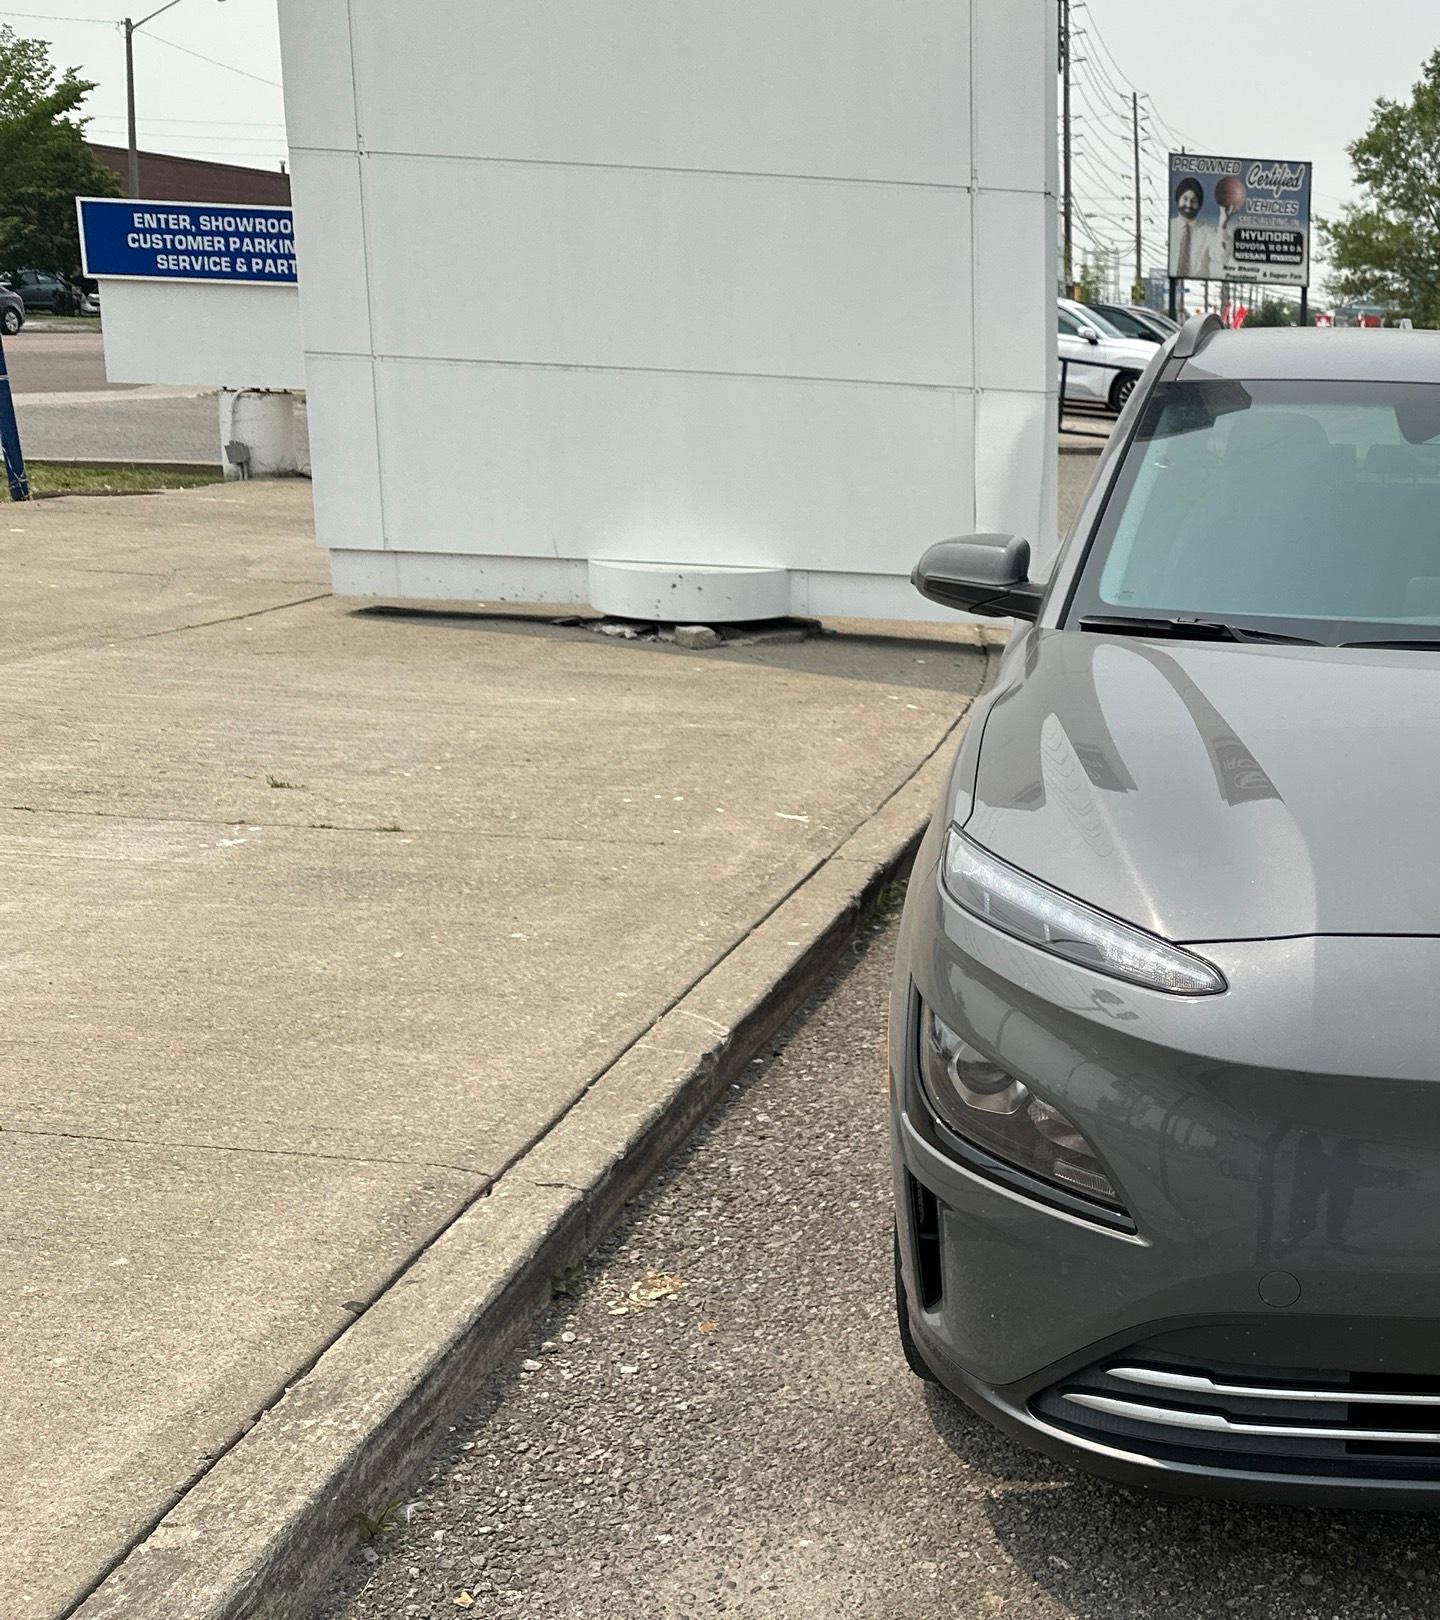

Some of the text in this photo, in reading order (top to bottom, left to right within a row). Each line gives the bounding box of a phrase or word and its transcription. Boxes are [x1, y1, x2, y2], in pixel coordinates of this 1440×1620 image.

[1171, 156, 1241, 176] PRE-OWNED
[1246, 162, 1305, 198] Certified
[1246, 198, 1299, 216] VEHICLES
[133, 213, 195, 232] ENTER,
[127, 233, 295, 254] CUSTOMER PARKIN
[1241, 230, 1295, 242] HYUNDAI
[1235, 241, 1266, 251] TOYOTA
[156, 254, 231, 272] SERVICE
[236, 258, 248, 273] &
[1234, 251, 1266, 261] NISSAN
